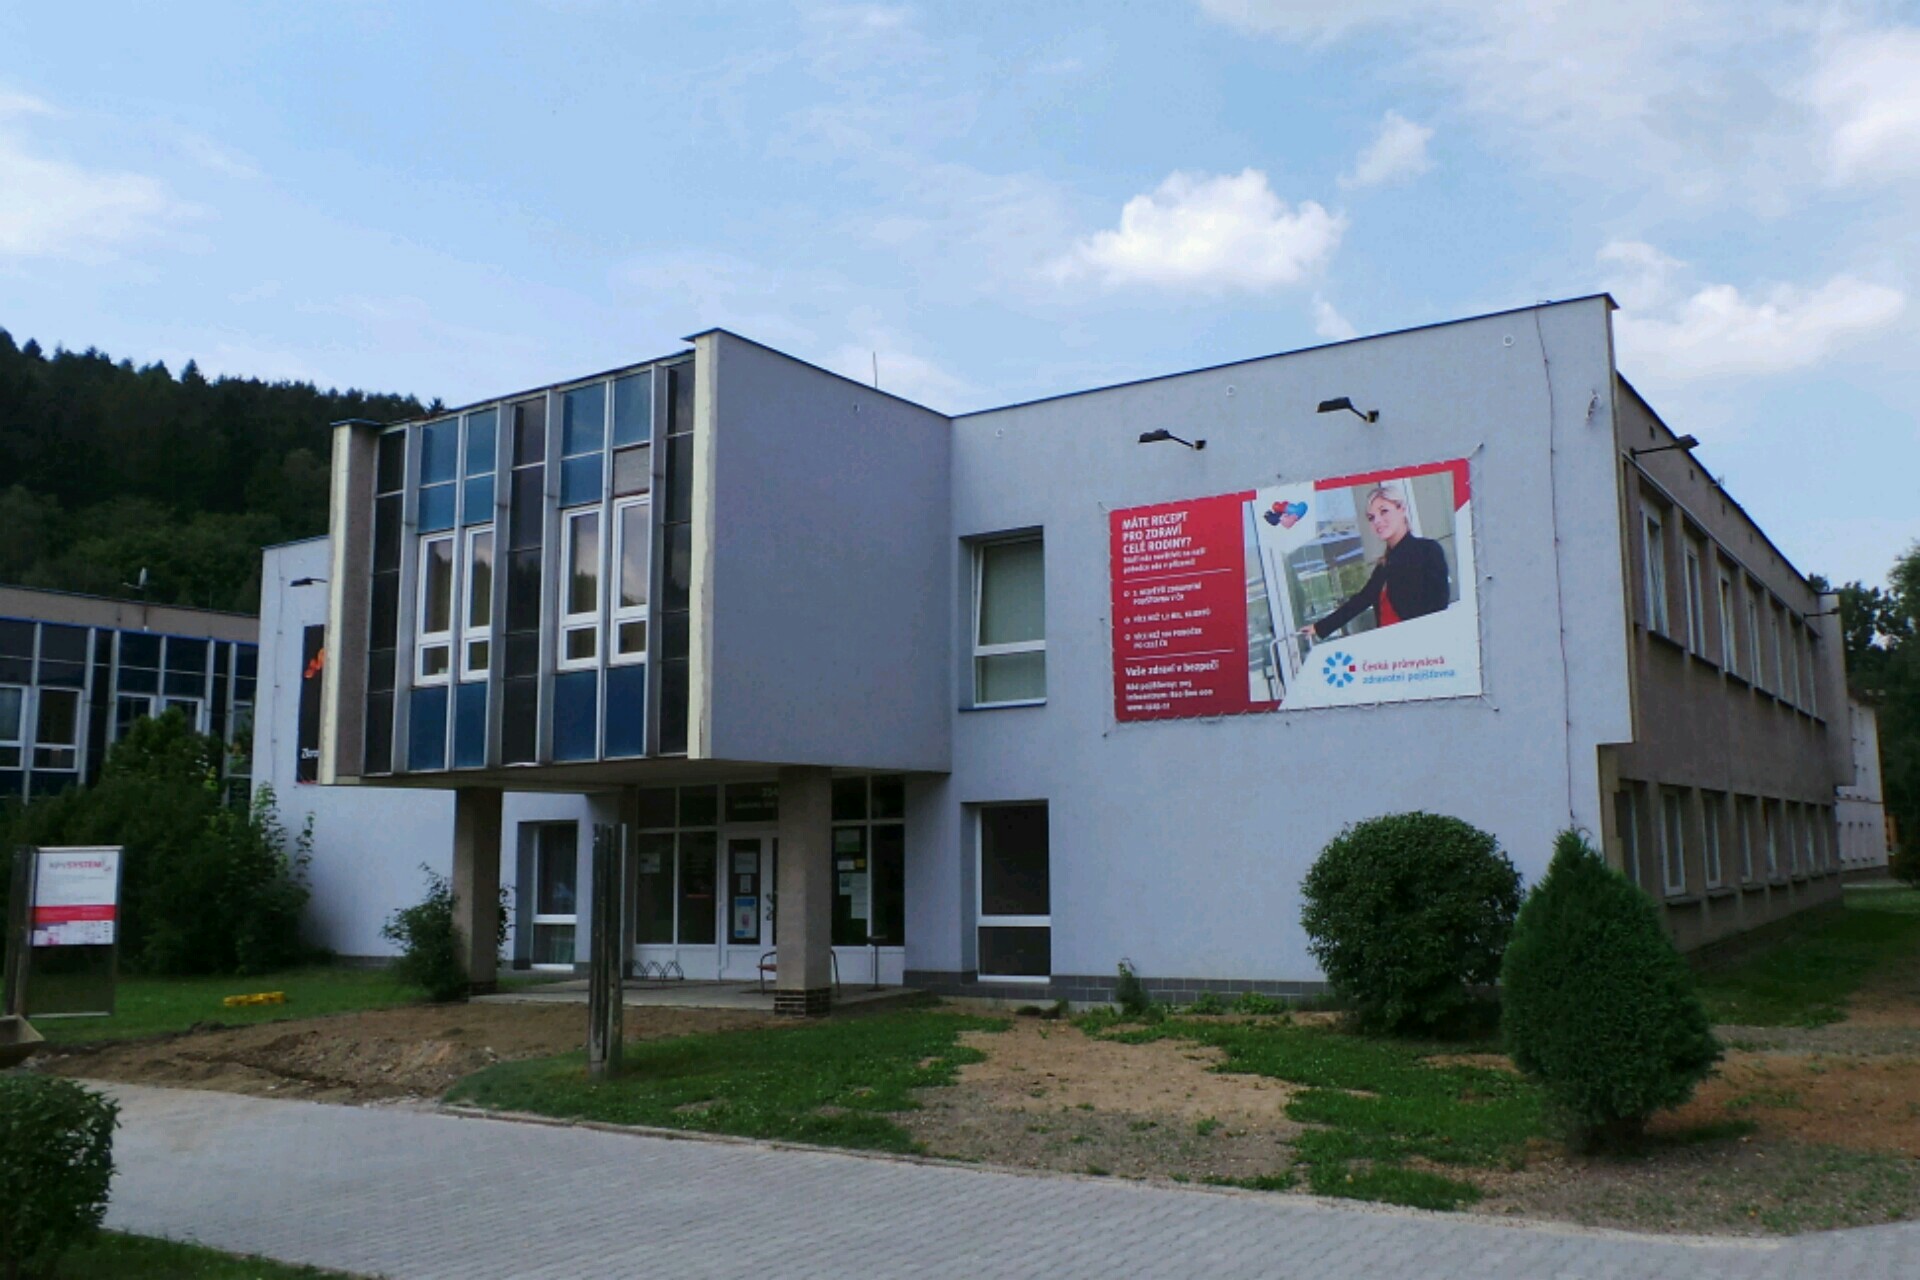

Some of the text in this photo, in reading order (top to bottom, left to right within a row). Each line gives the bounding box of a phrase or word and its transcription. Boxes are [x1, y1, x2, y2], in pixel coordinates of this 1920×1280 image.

[1123, 512, 1188, 528] MÁTE RECEPT
[1123, 523, 1182, 542] PRO ZDRAVÍ
[1123, 537, 1192, 554] CELÉ RODINY?
[1126, 666, 1146, 676] Vaše
[1147, 664, 1176, 674] zdraví
[1363, 656, 1445, 672] Česká průmyslová
